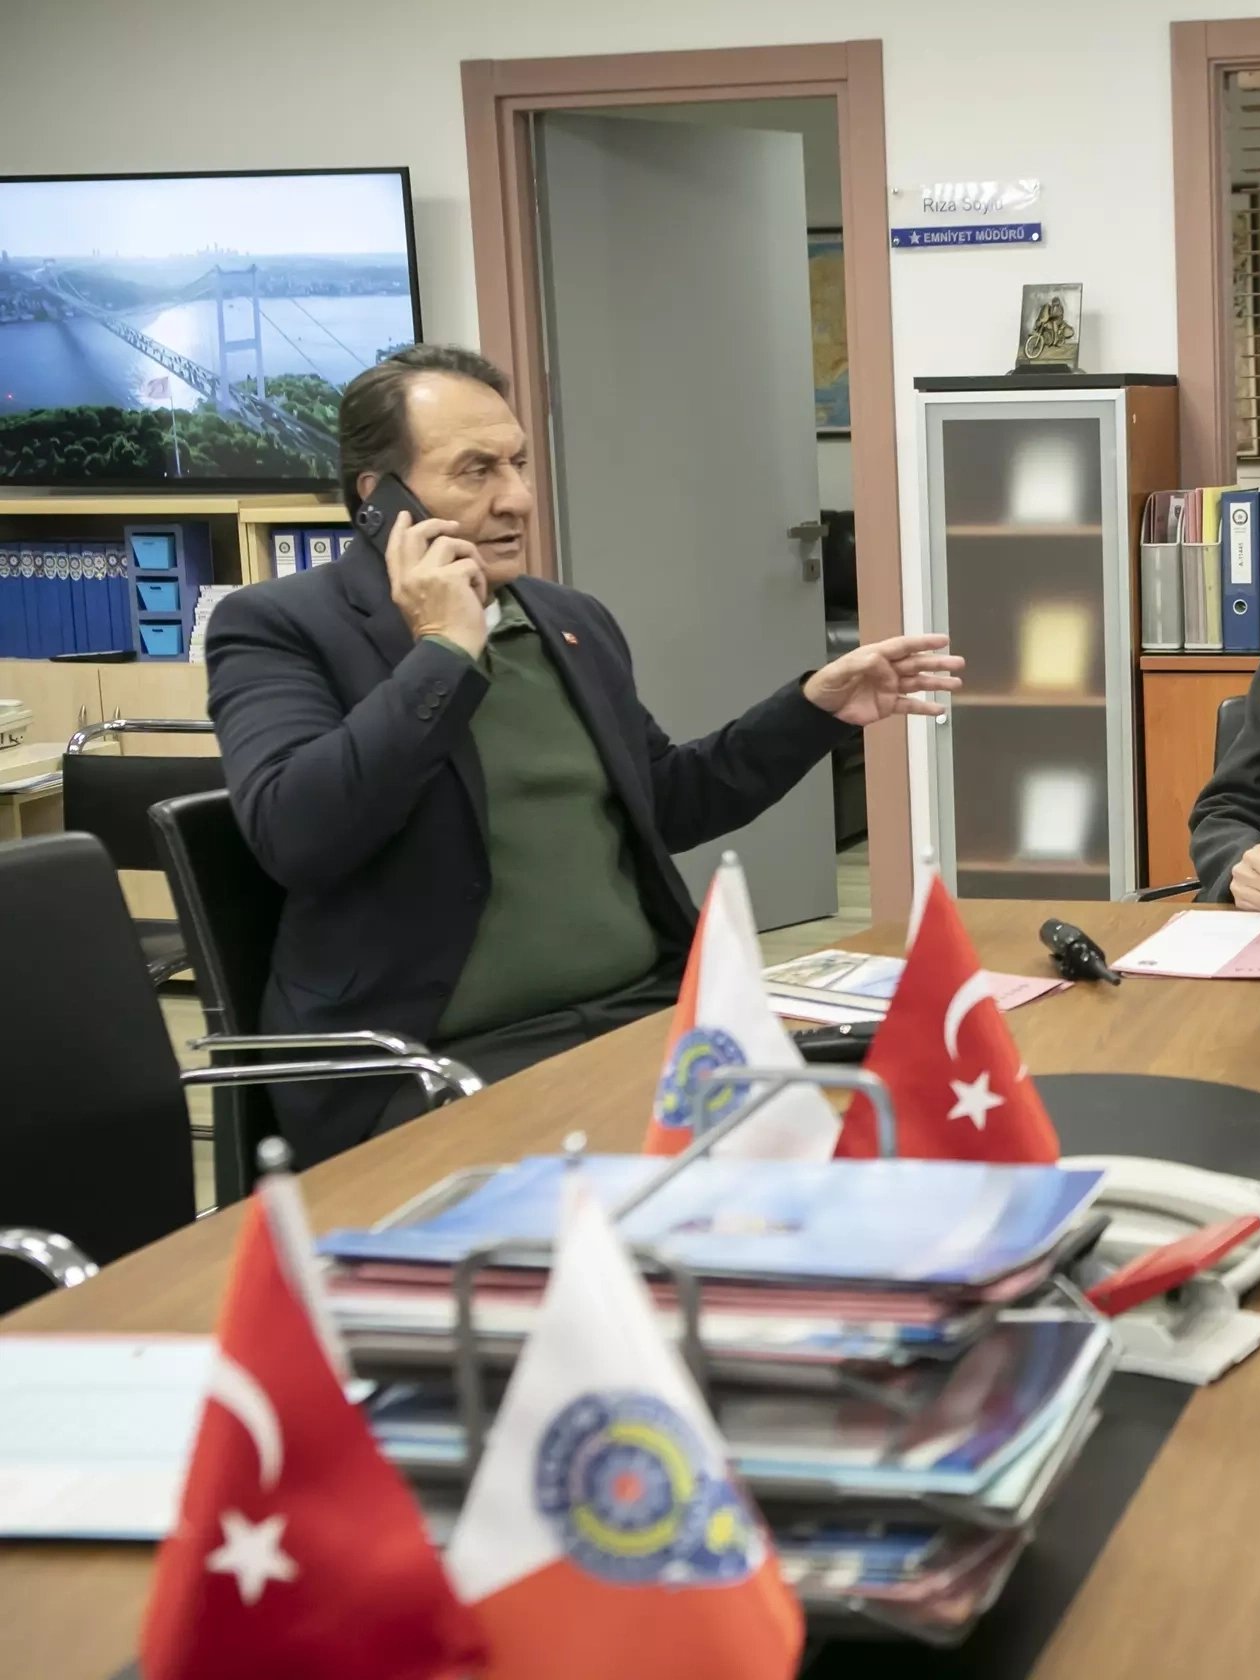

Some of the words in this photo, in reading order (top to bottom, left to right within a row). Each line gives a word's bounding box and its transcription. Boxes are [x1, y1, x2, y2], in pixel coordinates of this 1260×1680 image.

[923, 197, 956, 213] Rıza
[923, 229, 972, 243] EMNİYET
[976, 227, 1025, 241] MÜDÜRÜ
